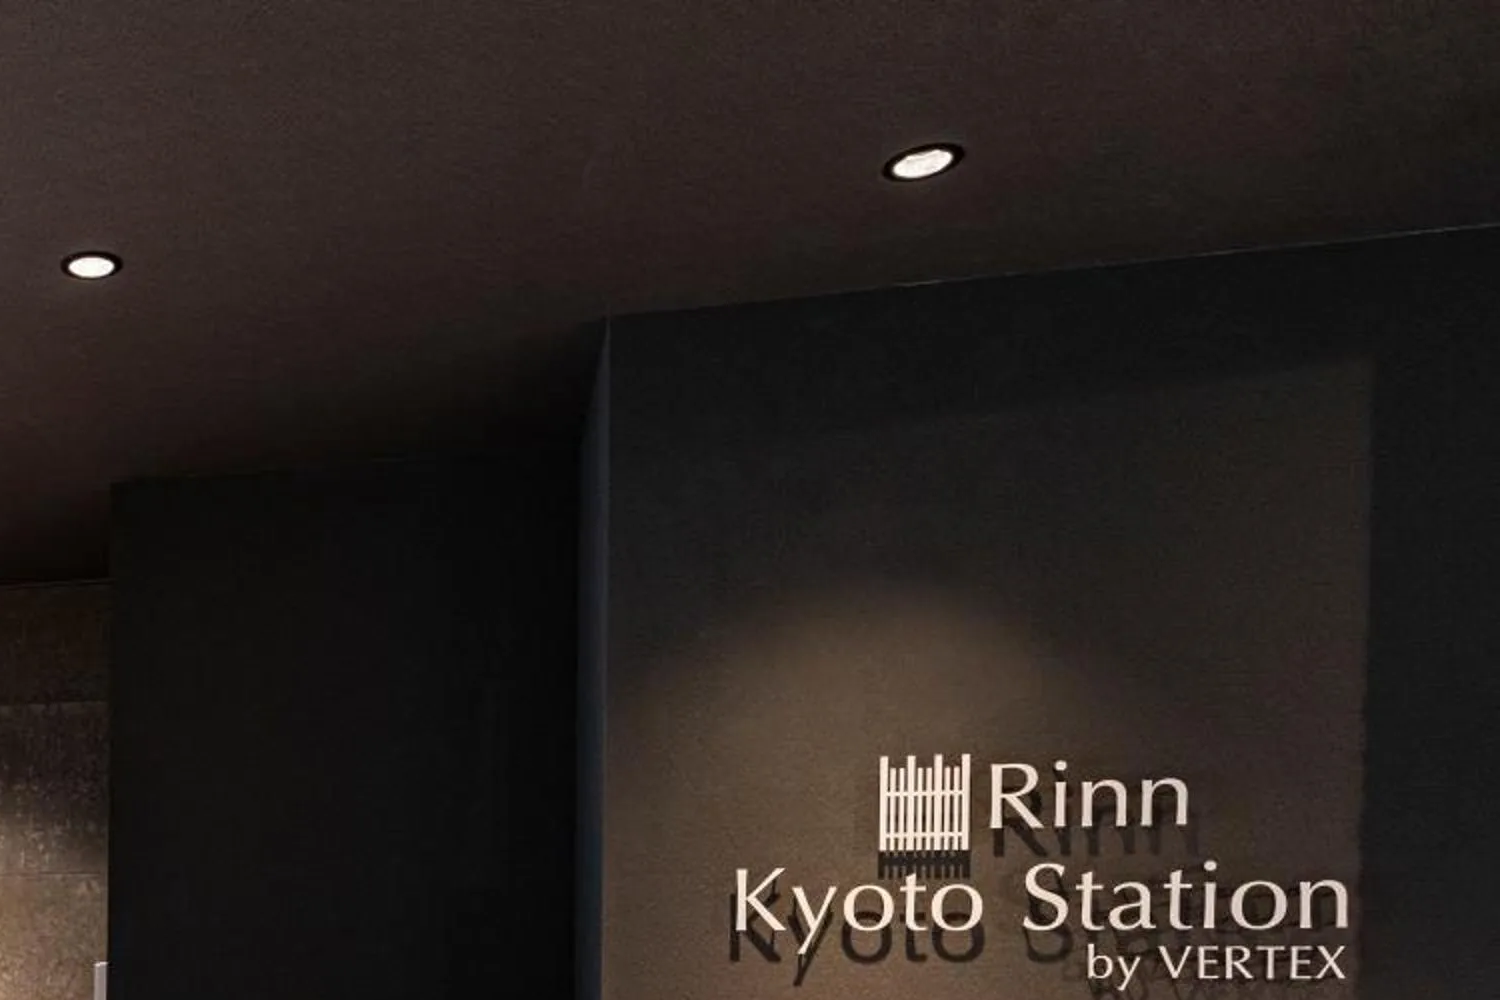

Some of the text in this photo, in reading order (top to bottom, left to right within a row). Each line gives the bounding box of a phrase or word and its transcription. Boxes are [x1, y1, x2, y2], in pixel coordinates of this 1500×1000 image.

[990, 760, 1188, 829] Rinn
[736, 860, 1348, 955] Kyoto Station
[1087, 944, 1346, 991] by VERTEX
